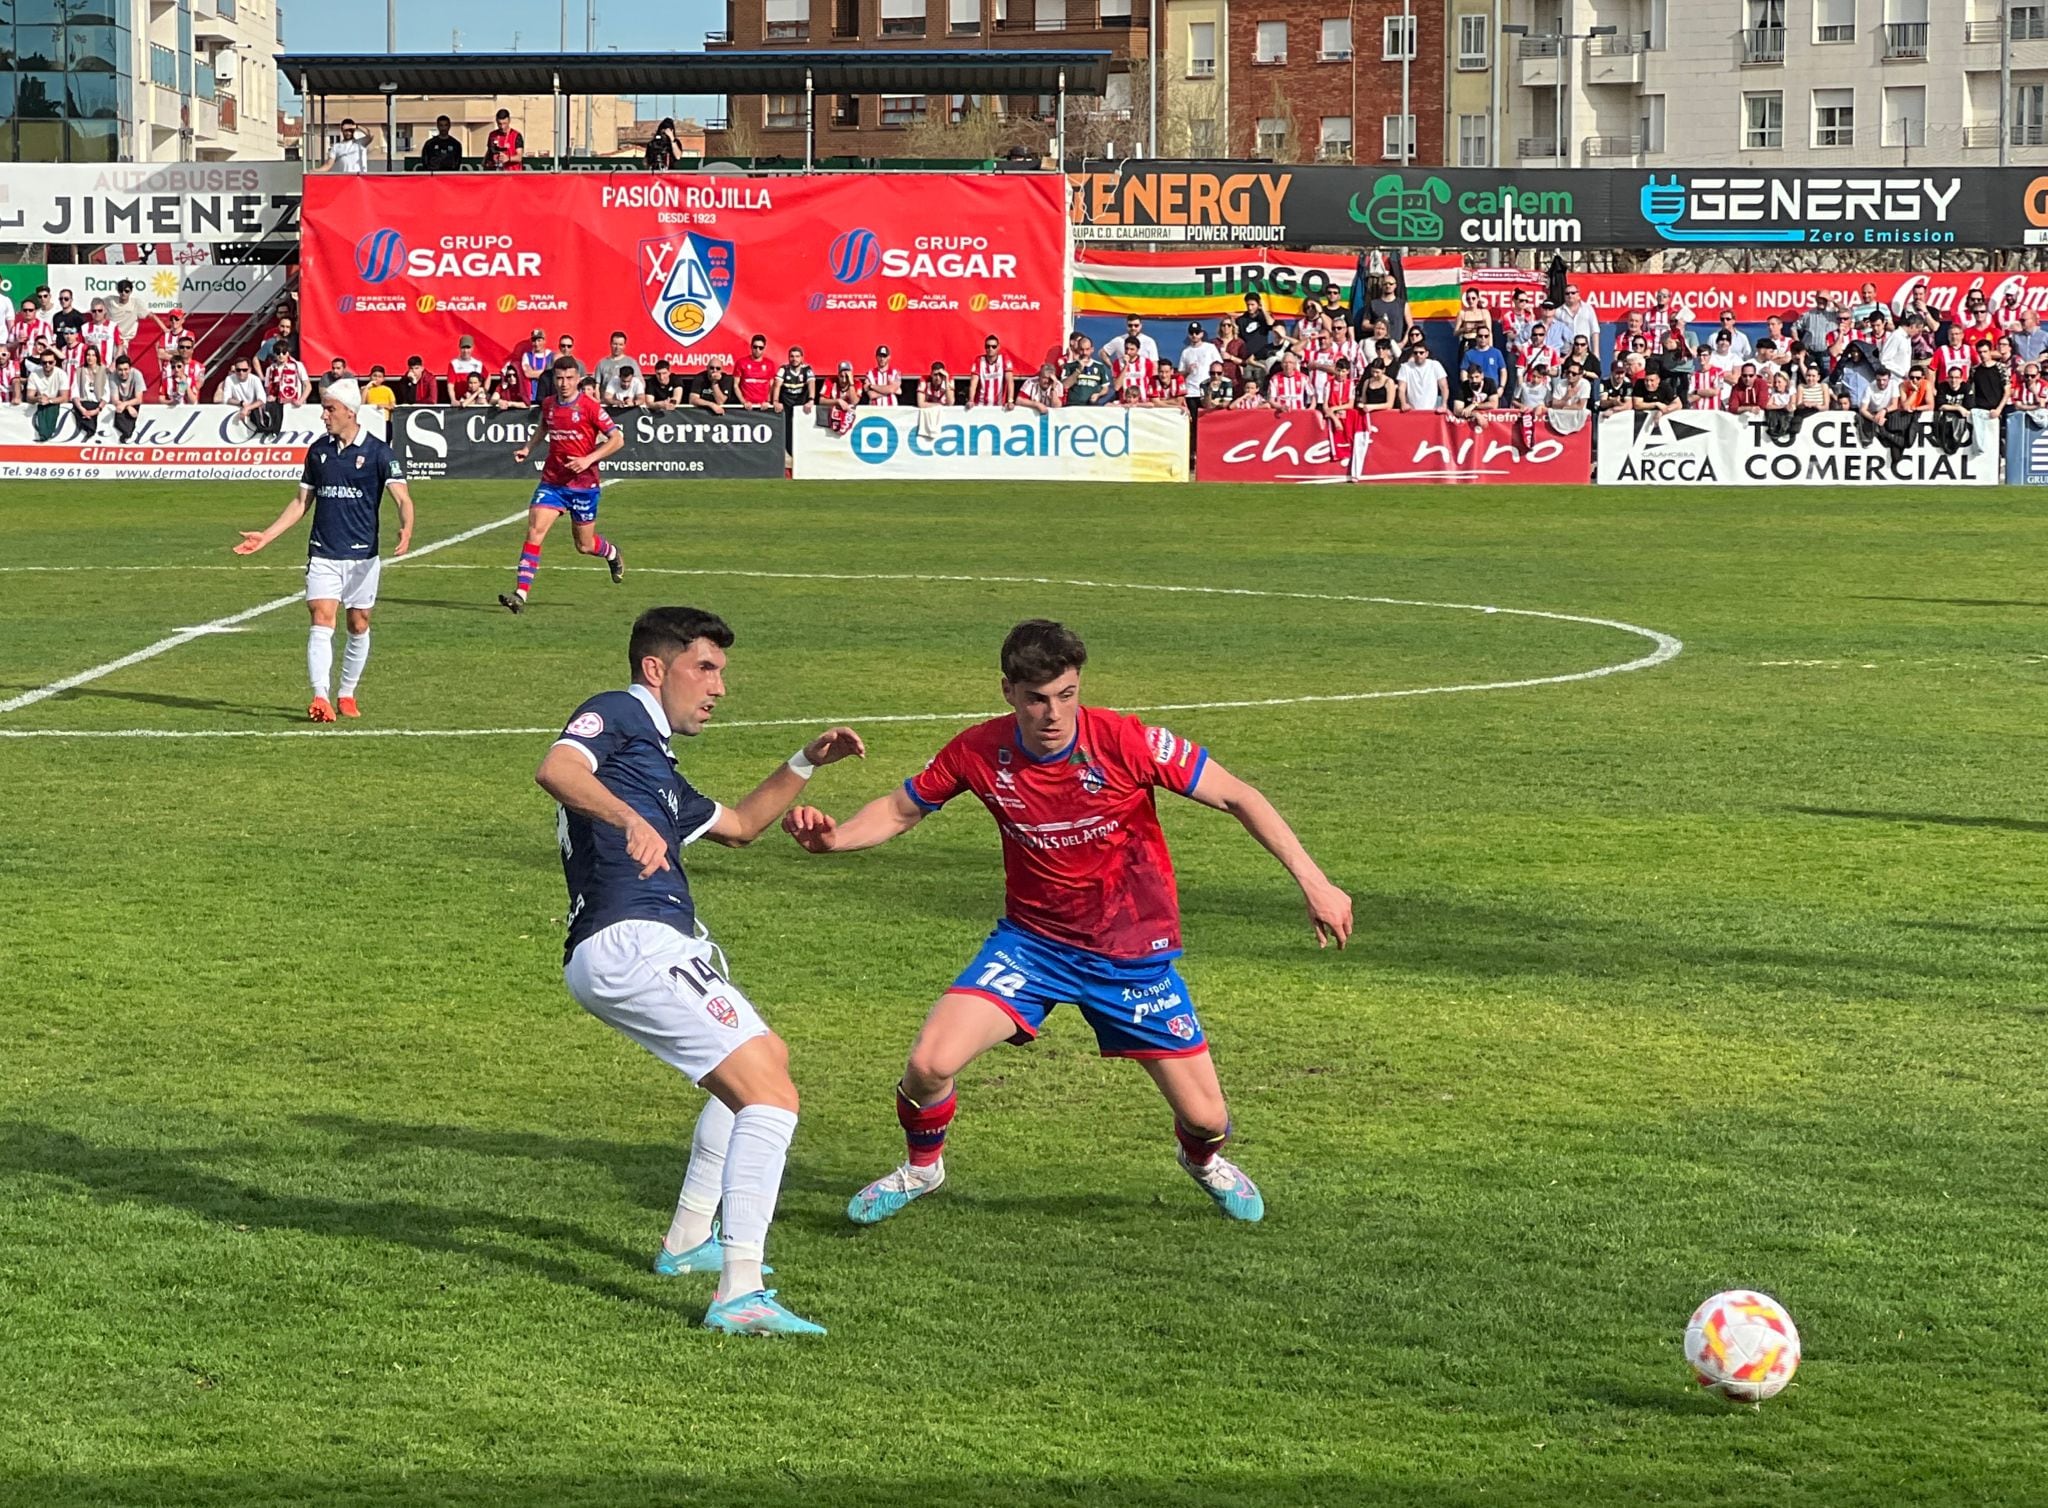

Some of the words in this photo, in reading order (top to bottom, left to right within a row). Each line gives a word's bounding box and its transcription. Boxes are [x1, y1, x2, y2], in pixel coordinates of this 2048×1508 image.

[93, 169, 259, 191] AUTOBUSES
[602, 181, 679, 208] PASIÓN
[686, 187, 771, 209] ROJILLA
[1458, 184, 1573, 214] canem
[1690, 178, 1961, 221] GENERGY
[43, 195, 302, 234] JIMENEZ
[658, 212, 690, 223] DESDE
[693, 213, 716, 224] 1923
[1460, 194, 1581, 242] cultum
[440, 235, 512, 249] GRUPO
[915, 236, 987, 250] GRUPO
[1097, 227, 1114, 239] C.D.
[1116, 227, 1171, 239] CALAHORRA!
[1187, 226, 1228, 241] POWER
[1231, 226, 1286, 241] PRODUCT
[1809, 230, 1854, 243] Zero
[1864, 229, 1955, 243] Emission
[408, 249, 542, 277] SAGAR
[882, 249, 1017, 278] SAGAR
[182, 277, 247, 291] Arnedo
[1195, 265, 1330, 299] TIRGO
[148, 301, 183, 309] semillas
[355, 301, 406, 311] SAGAR
[436, 301, 486, 311] SAGAR
[516, 300, 568, 310] SAGAR
[826, 300, 877, 310] SAGAR
[907, 300, 958, 310] SAGAR
[989, 300, 1040, 310] SAGAR
[1587, 285, 1733, 309] ALIMENACIÓN
[1756, 290, 1862, 308] INDUSRIA
[405, 408, 447, 458] S
[636, 416, 773, 444] Serrano
[908, 412, 1130, 458] canalred
[80, 447, 145, 462] Clínica
[151, 447, 293, 465] Dermatológica
[1412, 426, 1564, 465] nino
[3, 467, 22, 477] Tel.
[25, 468, 47, 478] 948
[50, 468, 64, 478] 69
[67, 468, 81, 478] 61
[84, 468, 100, 478] 69
[406, 460, 447, 469] Serrano
[1617, 454, 1718, 482] ARCCA
[1744, 453, 1977, 482] COMERCIAL
[1062, 835, 1082, 847] DEL
[668, 956, 725, 999] 14
[976, 962, 1028, 998] 14
